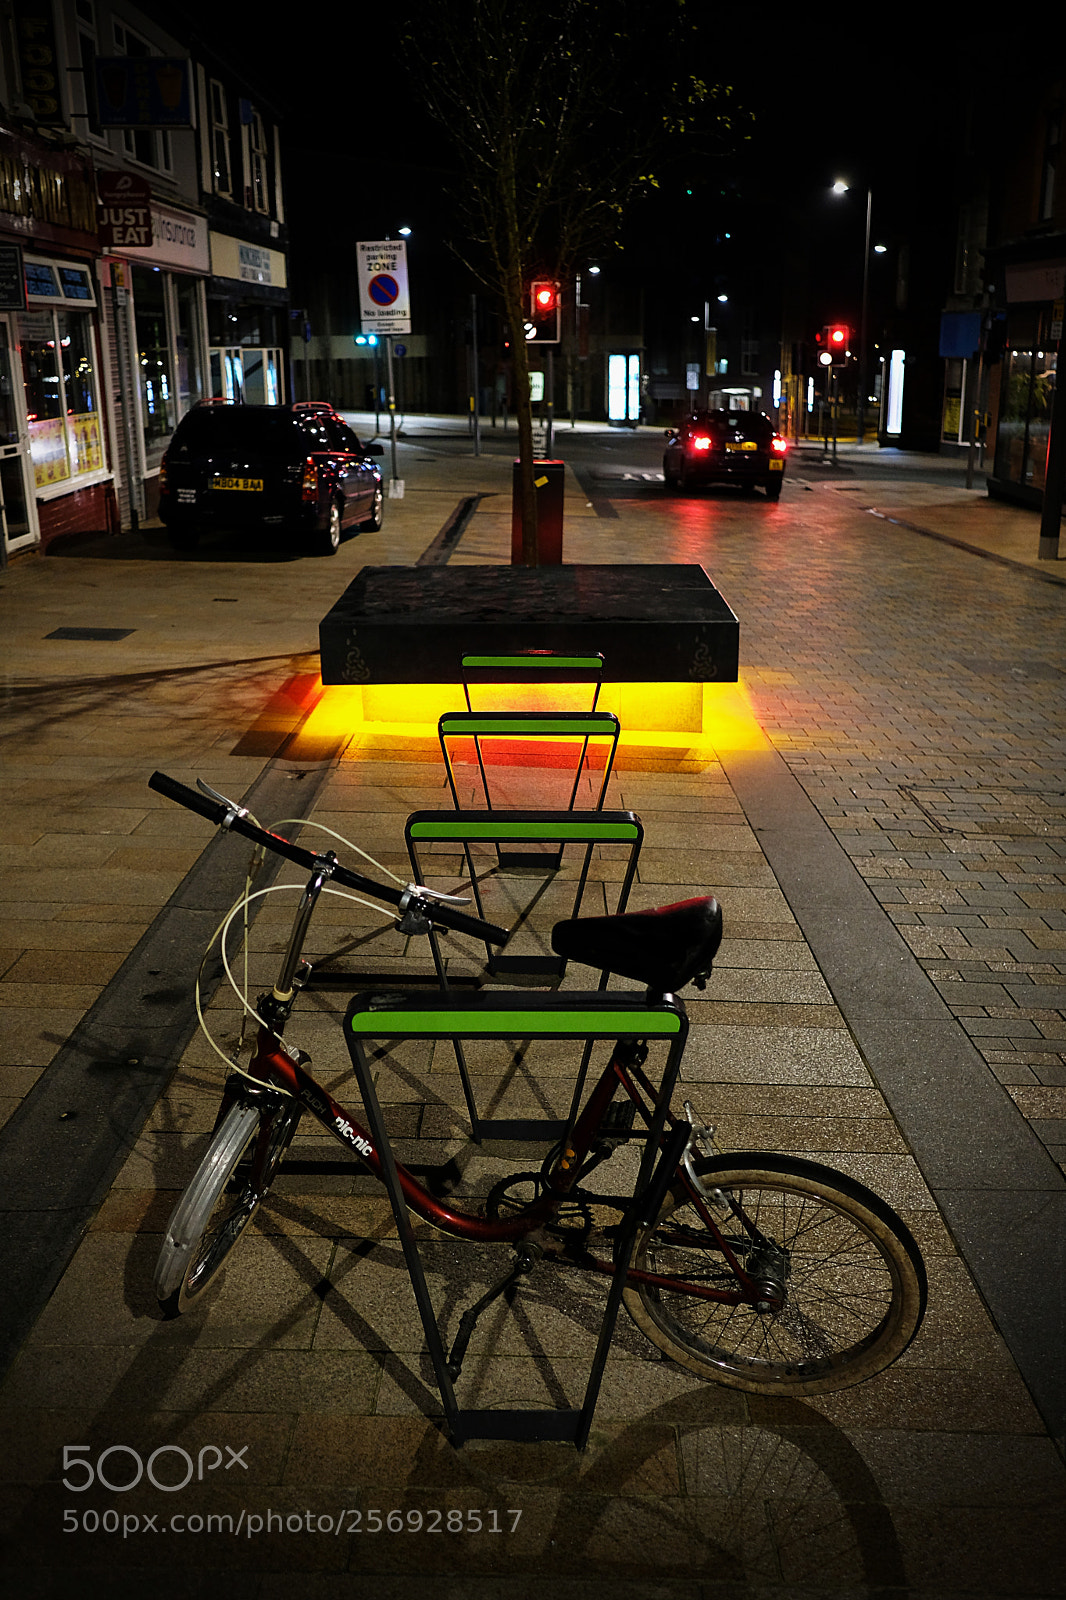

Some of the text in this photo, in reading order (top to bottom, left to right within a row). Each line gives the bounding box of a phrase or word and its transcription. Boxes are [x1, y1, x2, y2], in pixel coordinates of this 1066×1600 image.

[19, 16, 58, 115] FOOD
[99, 208, 147, 226] JUST
[112, 227, 149, 244] EAT
[360, 244, 403, 252] Restricted
[366, 253, 398, 262] parking
[367, 262, 398, 271] ZONE
[377, 309, 407, 317] loading
[300, 1089, 327, 1114] PUCH
